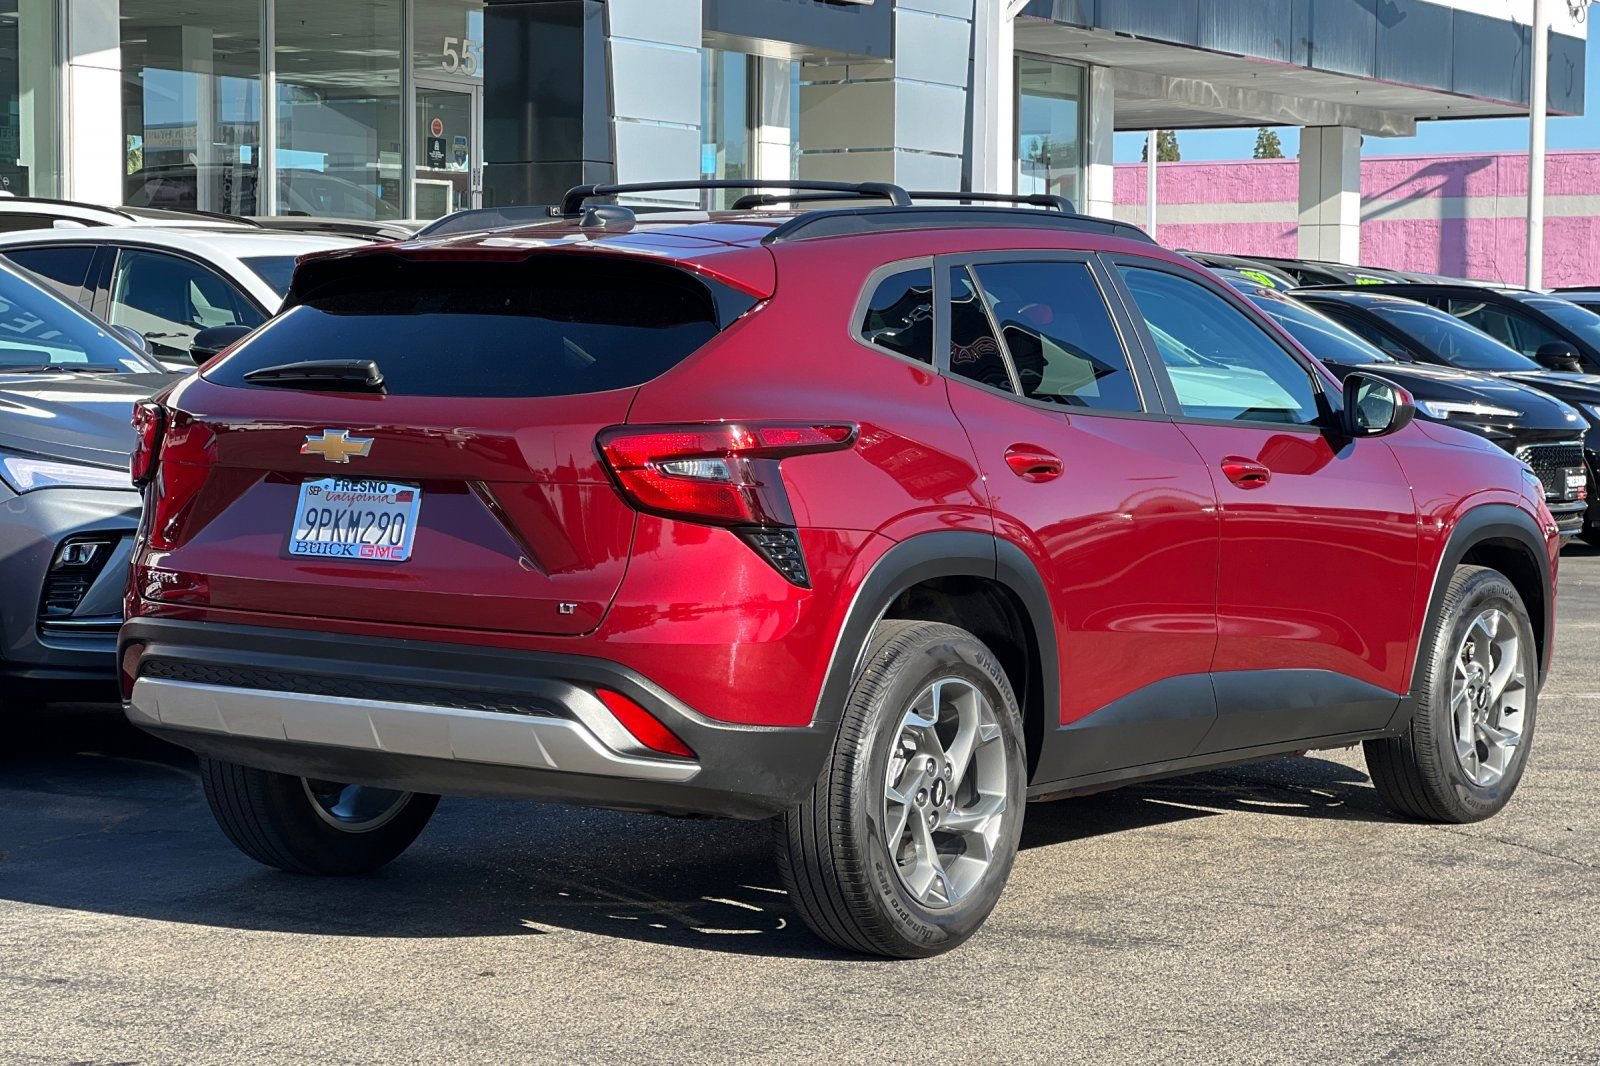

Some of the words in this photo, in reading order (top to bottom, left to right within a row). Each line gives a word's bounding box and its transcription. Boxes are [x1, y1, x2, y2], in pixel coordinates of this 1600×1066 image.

[440, 36, 484, 75] 55
[308, 485, 322, 496] SEP
[333, 480, 388, 493] FRESNO
[325, 491, 396, 507] California
[302, 507, 405, 545] 9PKM290
[295, 541, 354, 556] BUICK
[360, 545, 404, 559] GMC
[559, 602, 578, 615] LT
[890, 898, 934, 940] Dynapro
